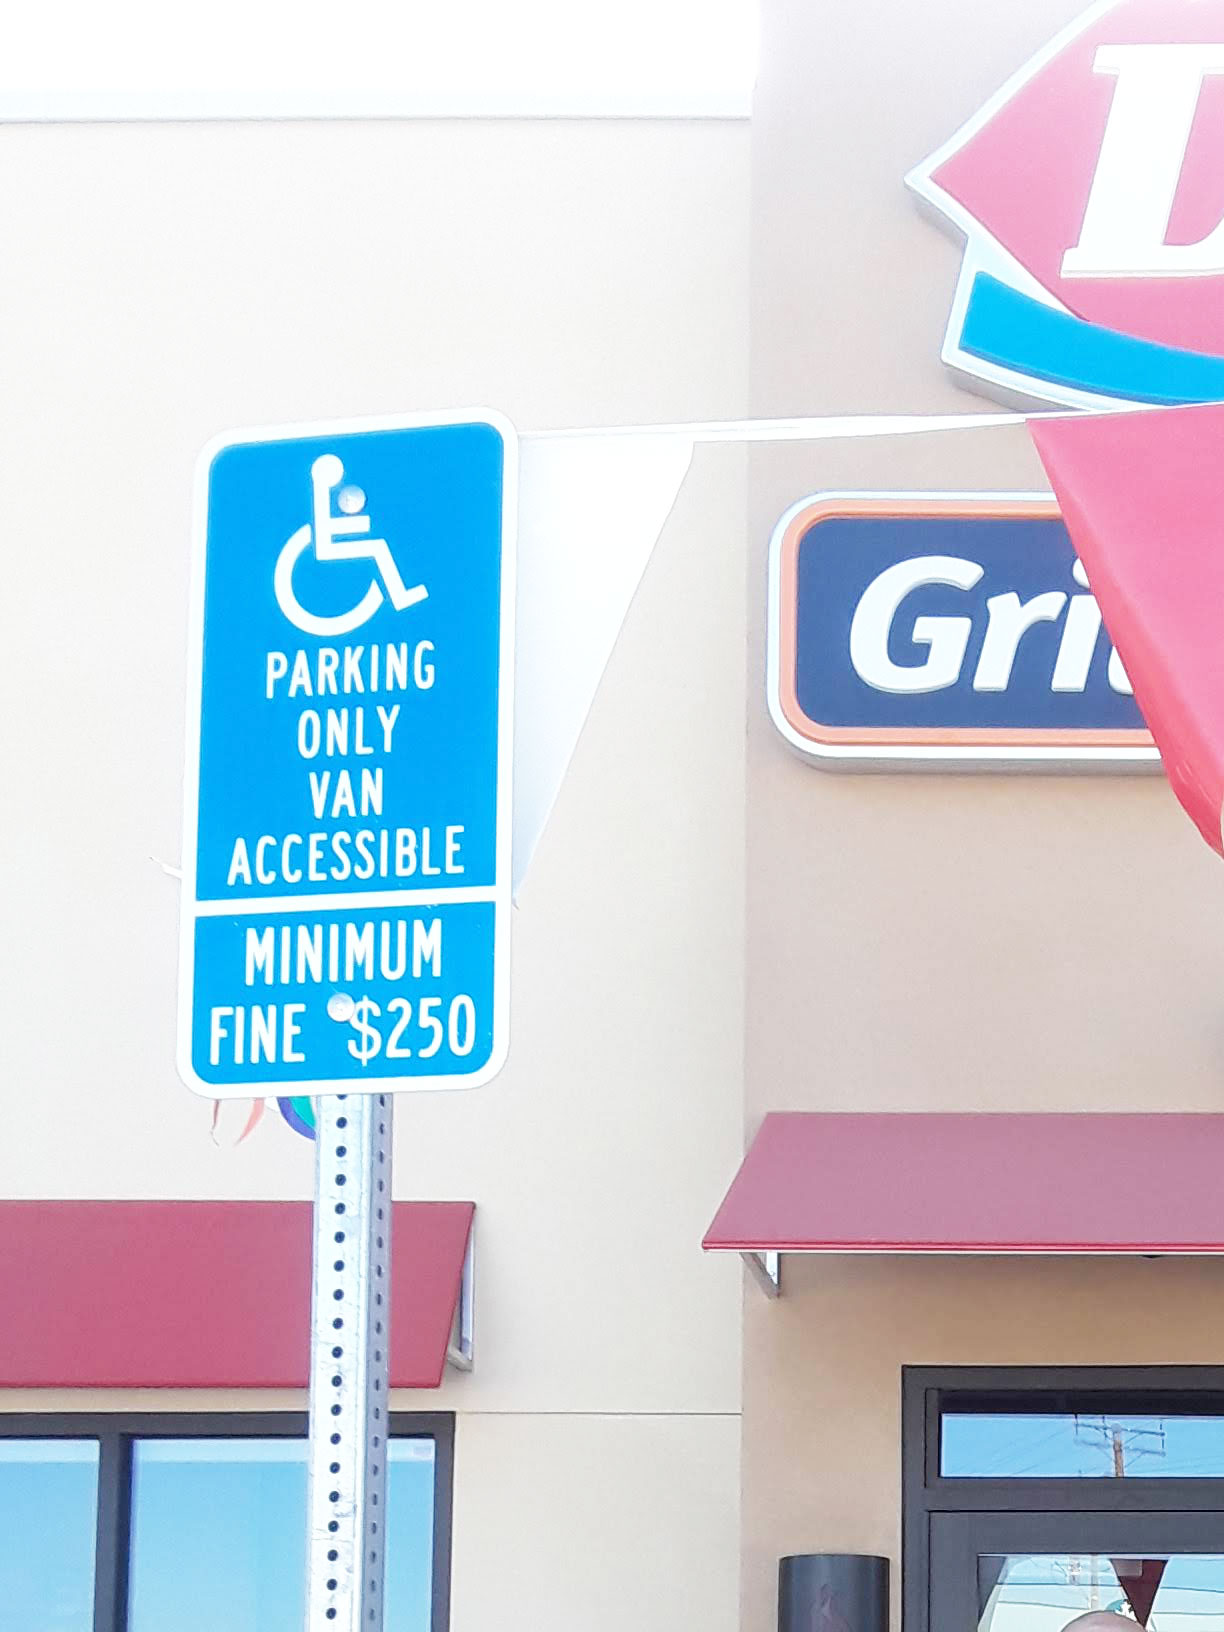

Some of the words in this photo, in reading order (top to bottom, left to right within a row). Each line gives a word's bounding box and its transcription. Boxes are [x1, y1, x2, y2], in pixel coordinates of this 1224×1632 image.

[849, 555, 1134, 696] Gri
[266, 640, 436, 699] PARKING
[297, 704, 400, 759] ONLY
[308, 767, 384, 819] VAN
[227, 825, 465, 886] ACCESSIBLE
[244, 918, 442, 986] MINIMUM
[209, 1003, 306, 1066] FINE
[347, 994, 477, 1067] $250
